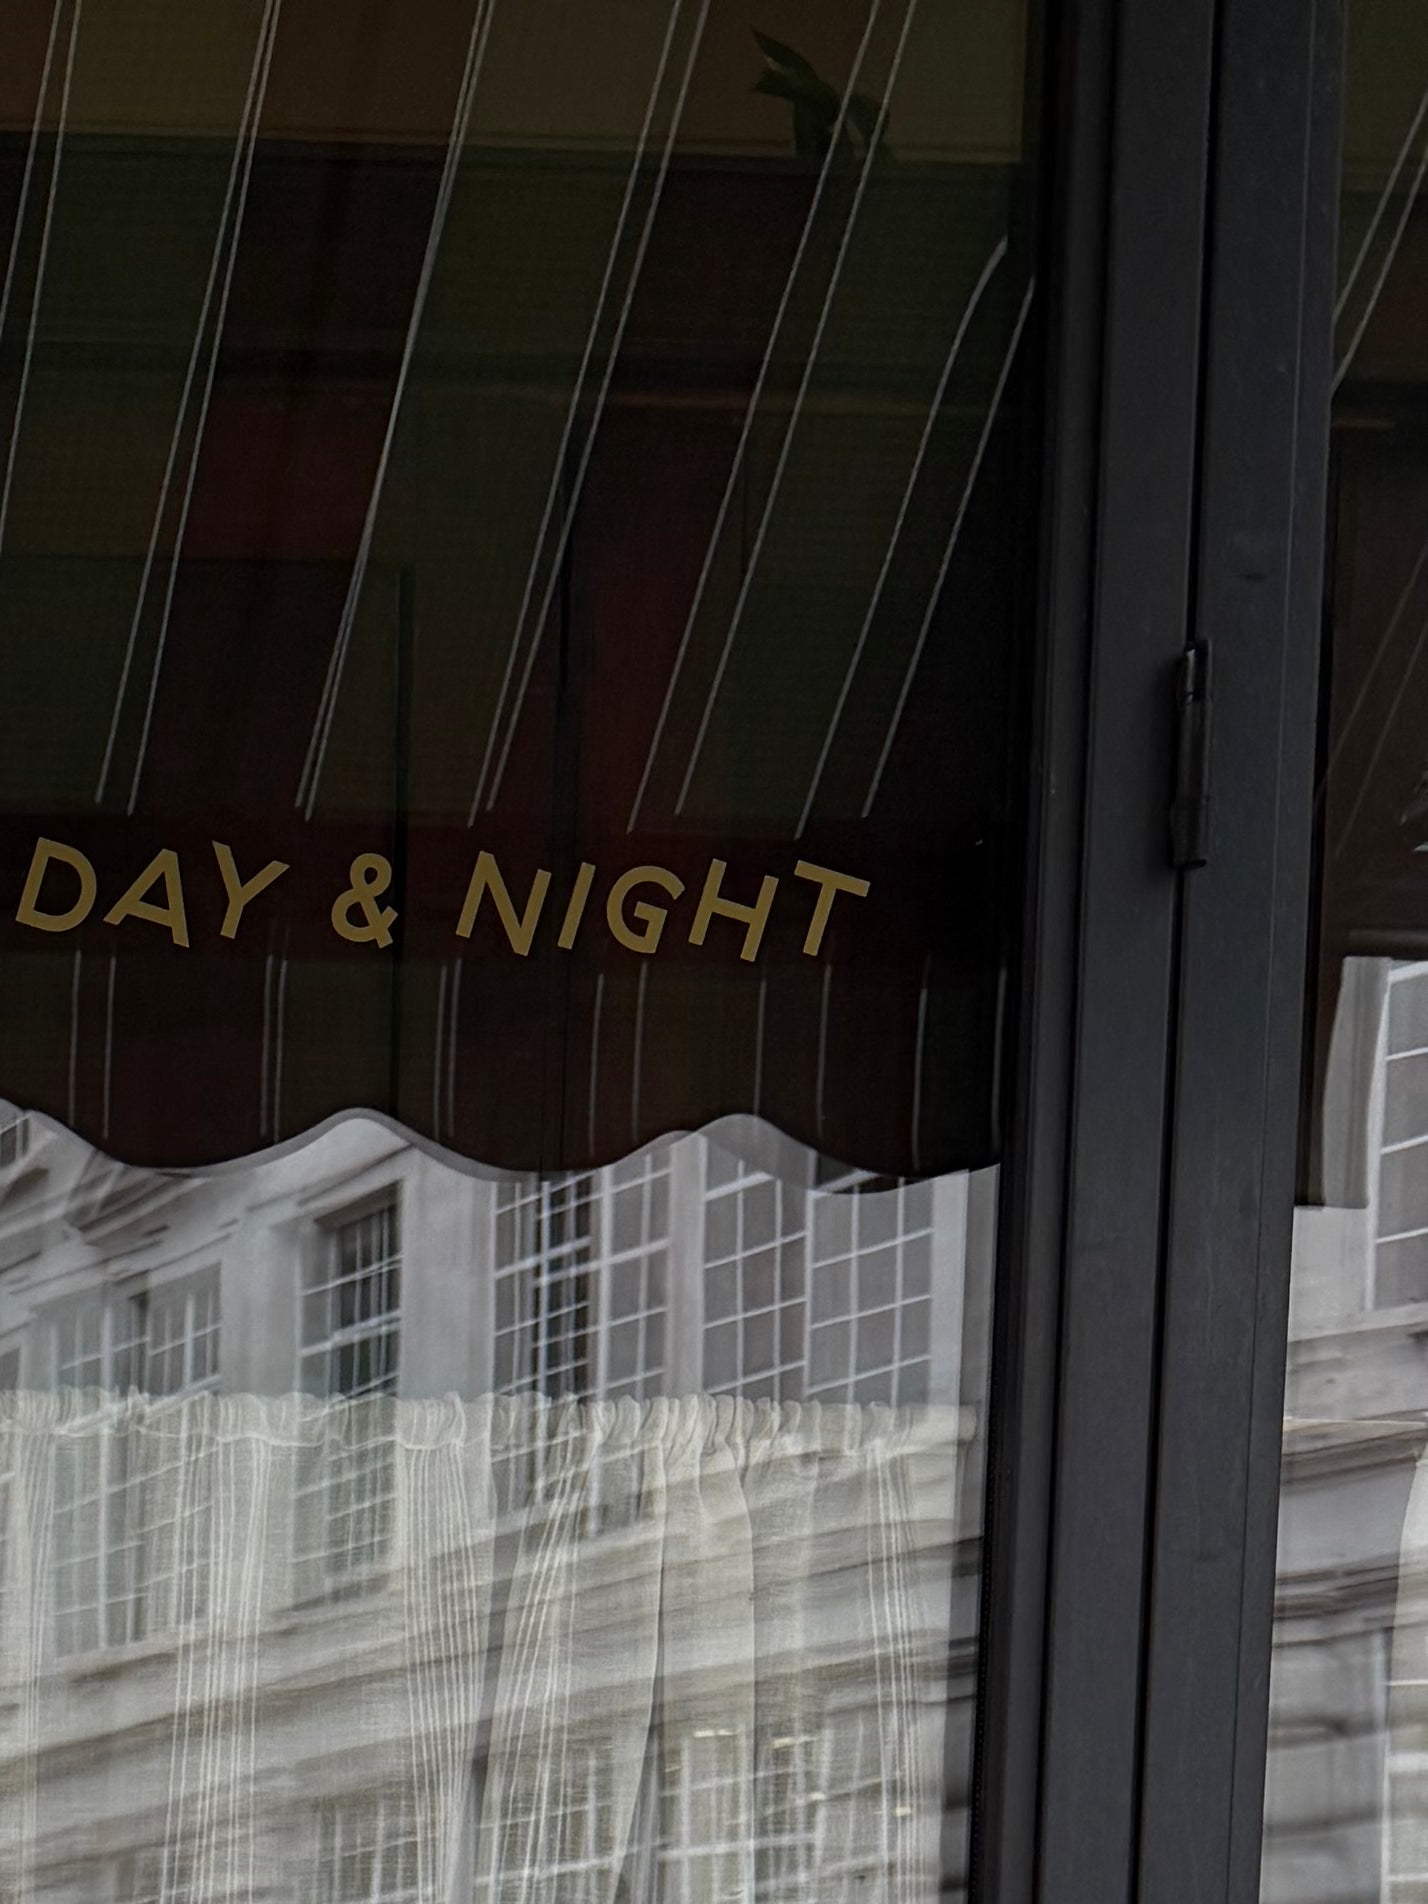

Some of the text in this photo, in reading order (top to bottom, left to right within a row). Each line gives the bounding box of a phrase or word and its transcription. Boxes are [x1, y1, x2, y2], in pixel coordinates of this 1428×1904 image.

[15, 836, 872, 962] DAY & NIGHT
